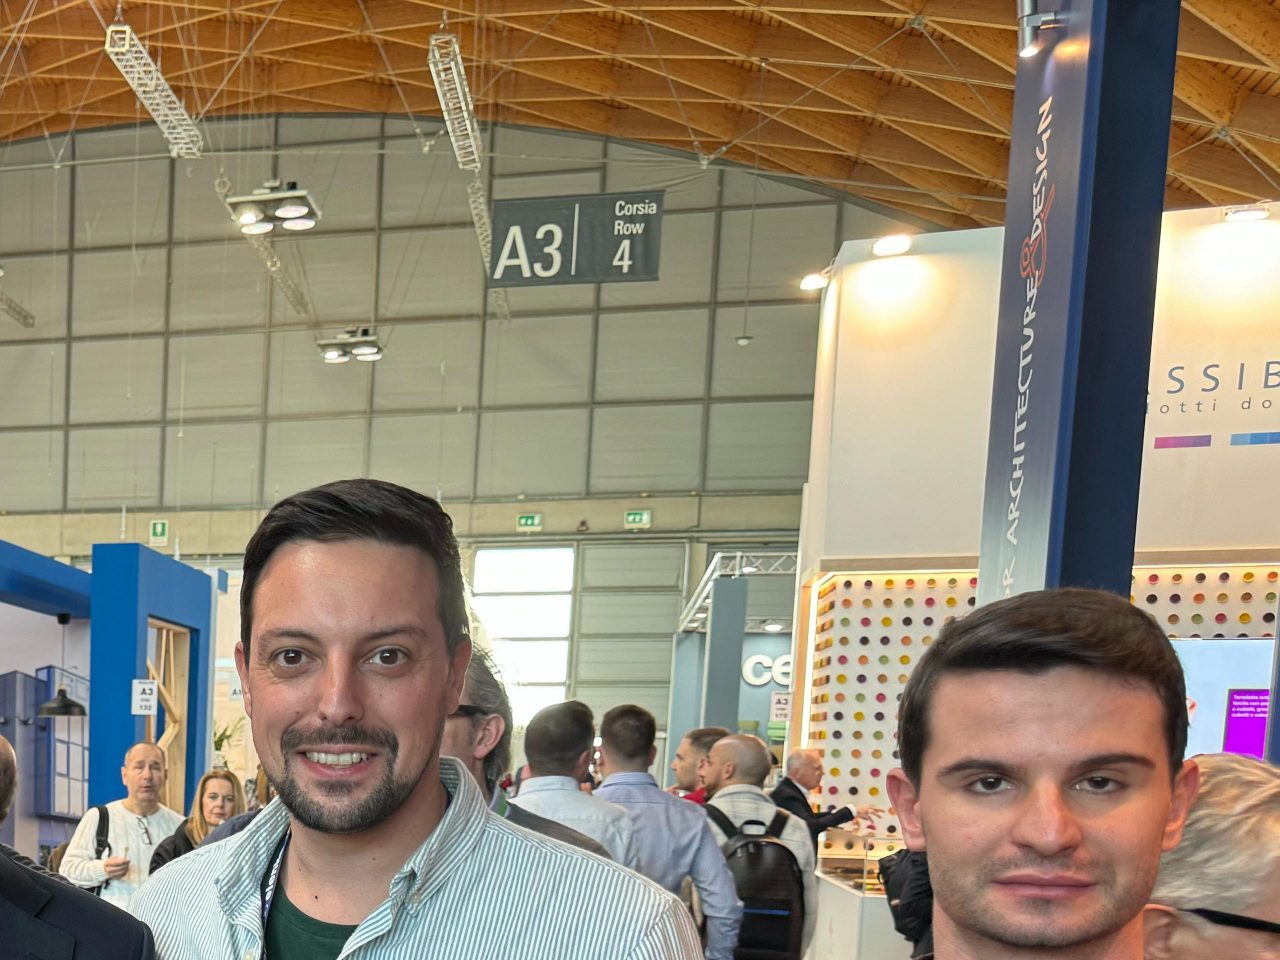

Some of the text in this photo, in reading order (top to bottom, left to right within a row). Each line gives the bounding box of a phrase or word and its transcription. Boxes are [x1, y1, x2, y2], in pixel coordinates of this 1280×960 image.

[614, 200, 657, 216] Corsia
[613, 219, 645, 236] Row
[492, 223, 563, 279] A3
[612, 239, 632, 273] 4
[1007, 270, 1039, 545] ARCHITECTURE
[1031, 96, 1053, 243] DESIGN
[1241, 397, 1272, 410] do
